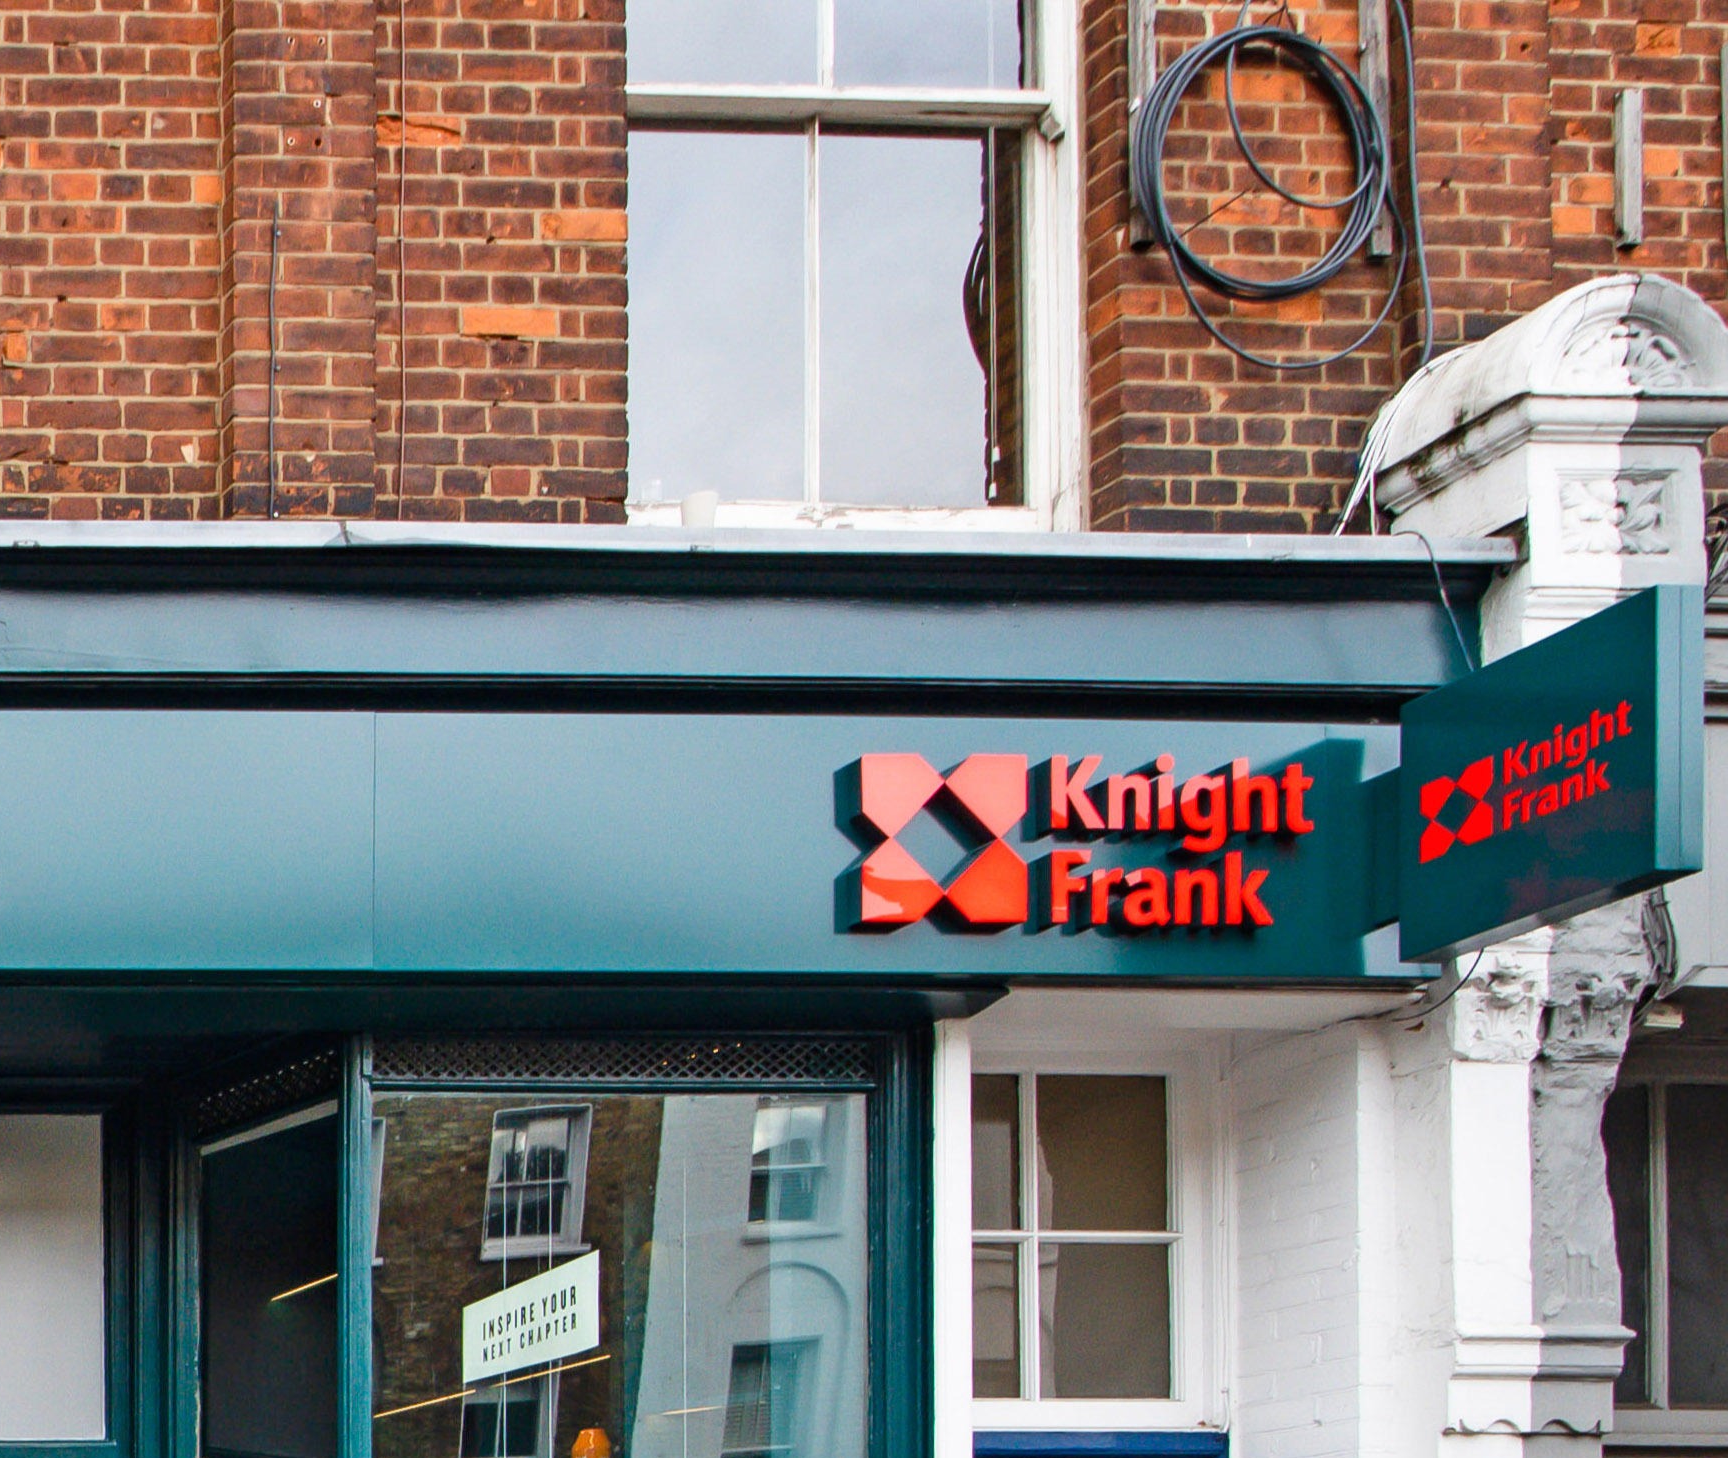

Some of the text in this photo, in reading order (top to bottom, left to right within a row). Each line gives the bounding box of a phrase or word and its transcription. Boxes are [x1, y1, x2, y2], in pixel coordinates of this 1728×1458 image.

[1503, 699, 1634, 783] Knight
[1050, 754, 1315, 852] Knight
[1503, 757, 1612, 831] Frank
[1050, 849, 1274, 926] Frank
[482, 1285, 579, 1342] INSPIRE YOUR
[482, 1314, 579, 1364] NEXT CHAPTER
